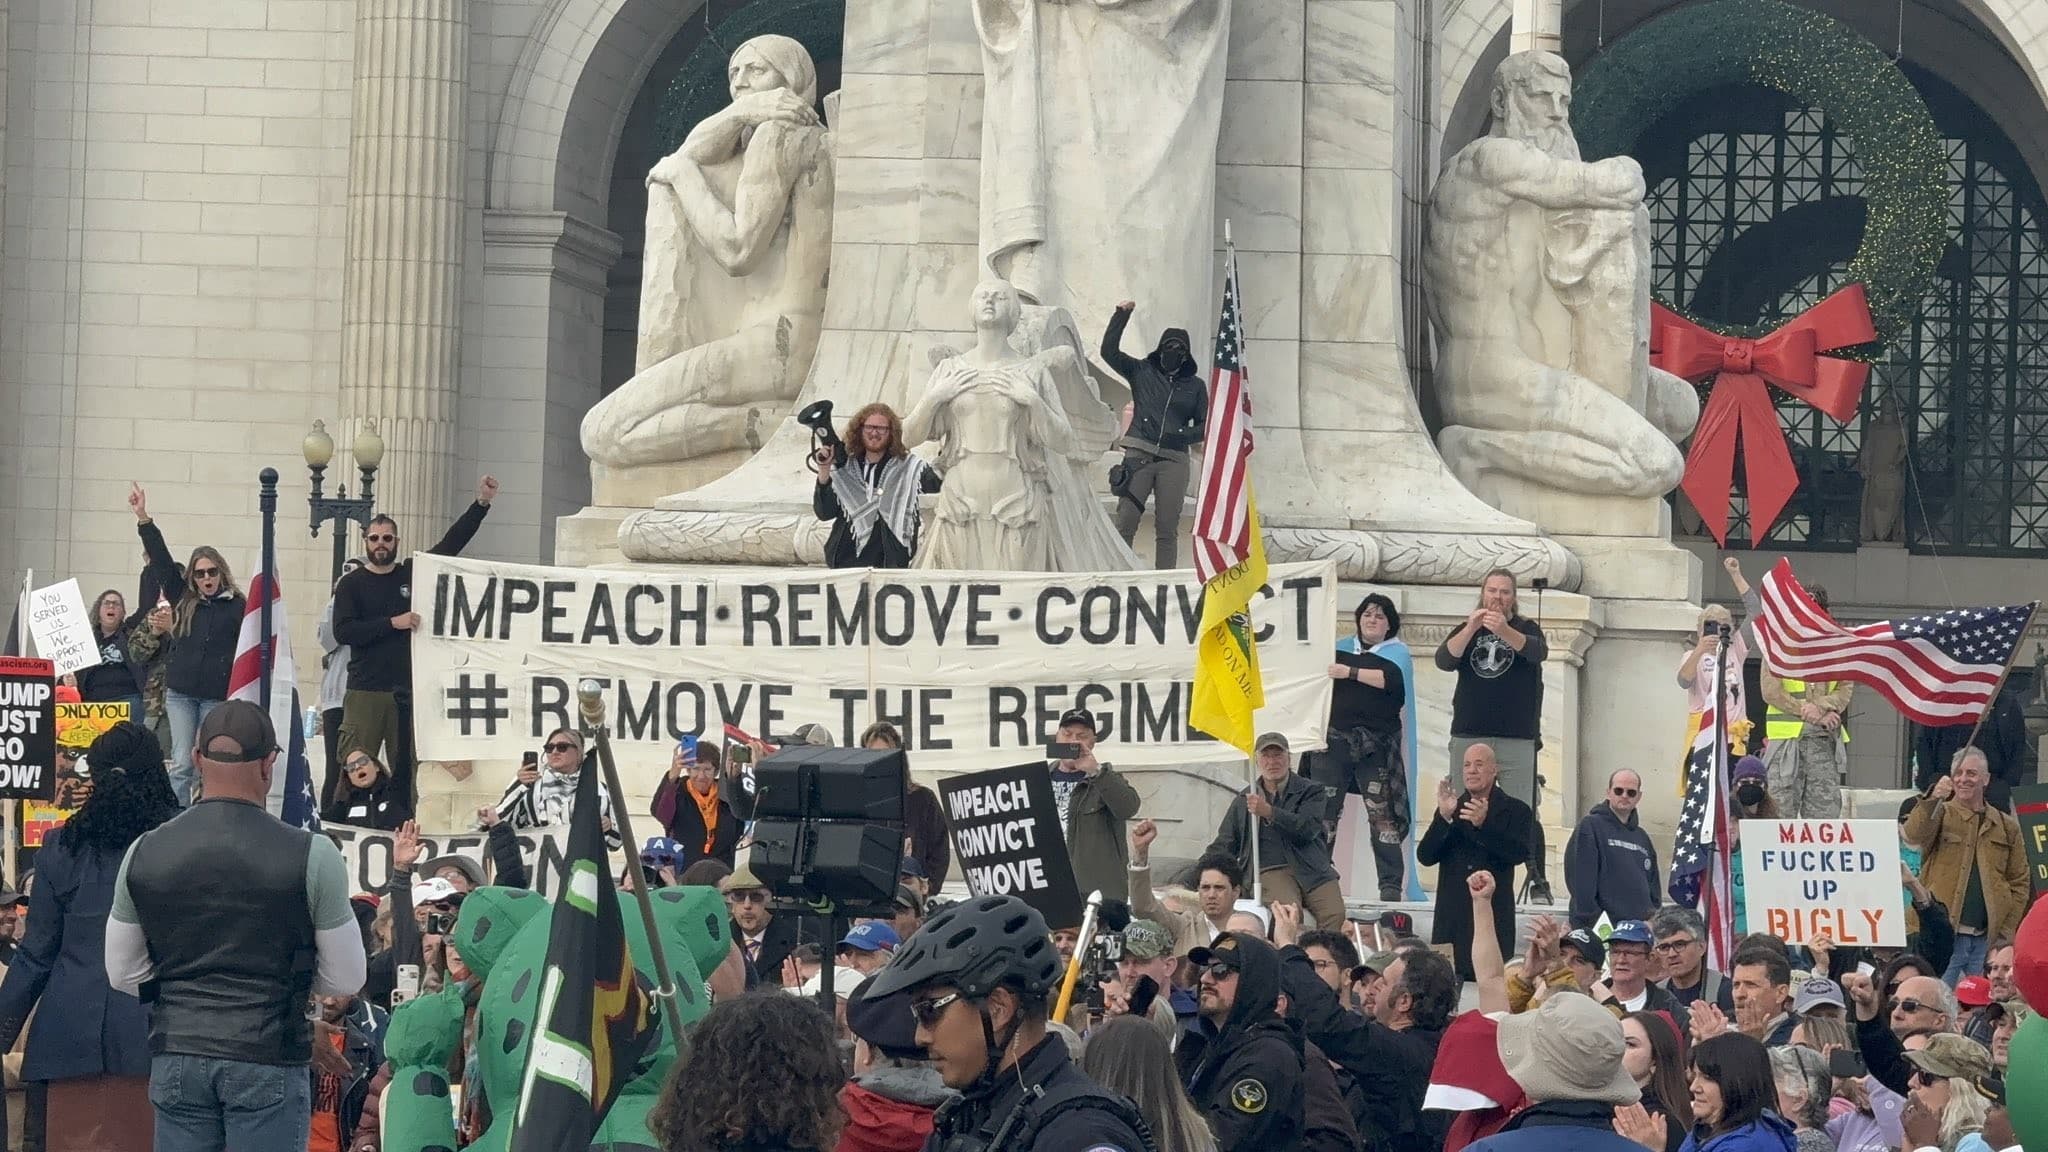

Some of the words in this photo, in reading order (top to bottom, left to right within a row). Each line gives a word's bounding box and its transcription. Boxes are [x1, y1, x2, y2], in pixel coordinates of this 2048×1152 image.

[40, 593, 61, 607] YOU
[432, 573, 708, 646] IMPEACH
[741, 581, 1001, 646] REMOVE
[1035, 576, 1323, 646] CONVCT
[33, 604, 69, 623] SERVED
[46, 641, 86, 662] SUPPORT
[1222, 646, 1242, 672] ON
[59, 656, 84, 672] YOU!
[55, 704, 94, 719] ONLY
[95, 703, 129, 719] YOU
[829, 687, 953, 750] THE
[948, 780, 1031, 820] IMPEACH
[957, 818, 1036, 858] CONVICT
[1778, 822, 1854, 844] MAGA
[1761, 850, 1876, 873] FUCKED
[1803, 879, 1838, 901] UP
[1767, 908, 1884, 944] BIGLY
